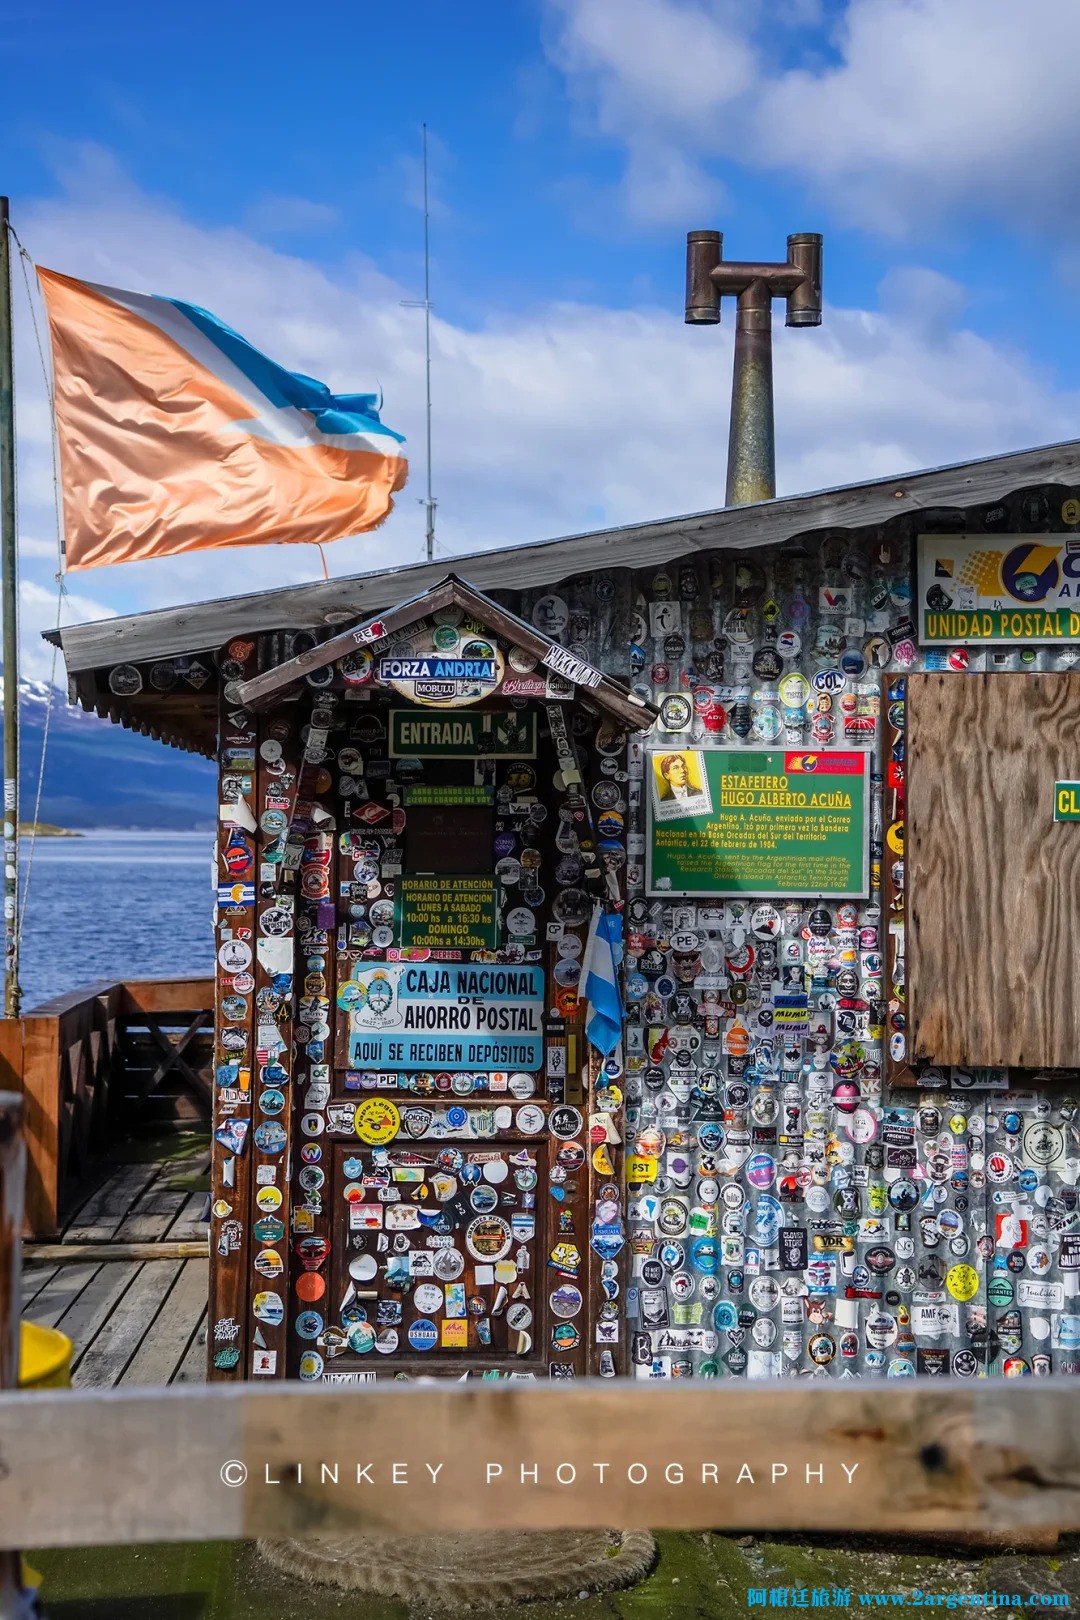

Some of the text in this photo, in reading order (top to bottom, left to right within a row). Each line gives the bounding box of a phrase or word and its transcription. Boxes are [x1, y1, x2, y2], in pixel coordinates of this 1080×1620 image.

[927, 614, 993, 638] UNIDAD
[1001, 613, 1063, 637] POSTAL
[382, 661, 495, 678] FORZA ANDRIA!
[816, 674, 842, 689] COL
[417, 684, 455, 694] MOBULU
[400, 722, 475, 745] ENTRADA
[721, 775, 788, 789] ESTAFETERO
[721, 791, 852, 807] HUGO ALBERTO ACUÑA
[720, 814, 738, 823] Hugo
[775, 814, 803, 823] enviado
[805, 816, 817, 825] por
[818, 815, 826, 823] el
[827, 815, 851, 824] Correo
[756, 824, 767, 832] por
[769, 823, 796, 832] primera
[655, 830, 687, 838] Nacional
[726, 831, 755, 839] Orcadas
[796, 833, 827, 841] Territorio
[721, 840, 746, 848] febrero
[402, 878, 493, 889] HORARIO DE ATENCIÓN
[406, 893, 440, 902] HORARIO
[442, 894, 452, 902] DE
[416, 904, 482, 913] LUNES A SABADO
[406, 913, 429, 923] 10:00
[431, 914, 441, 923] hs
[457, 913, 480, 923] 16:30
[481, 914, 492, 924] hs
[428, 924, 469, 935] DOMINGO
[411, 936, 485, 946] 10:00hs a 14:30hs
[677, 936, 691, 946] PE
[406, 969, 538, 996] CAJA NACIONAL
[457, 996, 484, 1005] DE
[404, 1005, 538, 1031] AHORRO POSTAL
[354, 1039, 534, 1064] AQUÍ SE RECIBEN DEPÓSITOS
[632, 1163, 650, 1172] PST
[1055, 1213, 1079, 1232] RIVA
[822, 1237, 844, 1246] VDR
[553, 1246, 580, 1266] 42
[921, 1308, 937, 1319] AMF
